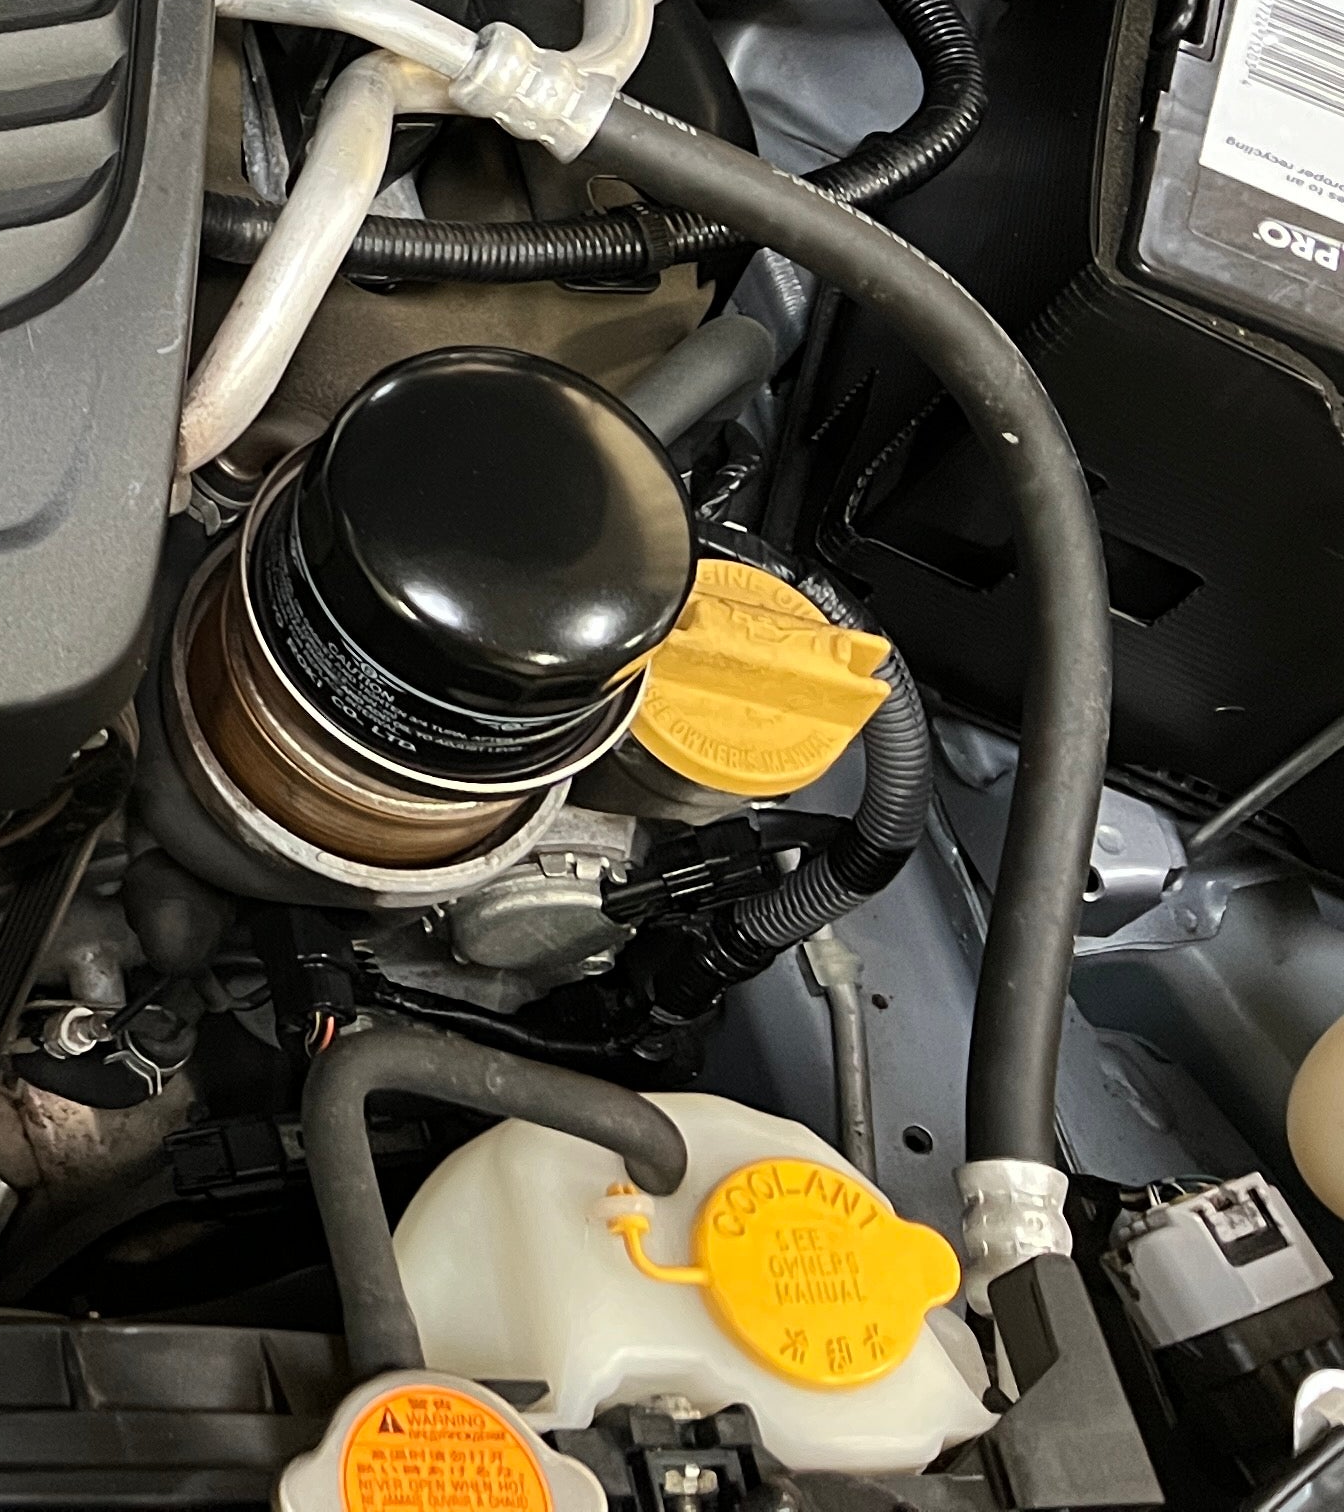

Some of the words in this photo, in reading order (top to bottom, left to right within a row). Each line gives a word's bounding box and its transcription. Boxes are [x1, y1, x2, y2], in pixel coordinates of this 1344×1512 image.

[1224, 135, 1294, 171] recycling
[1285, 174, 1305, 187] an
[1308, 183, 1324, 196] to
[699, 569, 763, 594] GINE
[327, 640, 395, 704] CAUTION
[712, 1164, 879, 1238] COOLANT
[407, 1413, 485, 1429] WARNING
